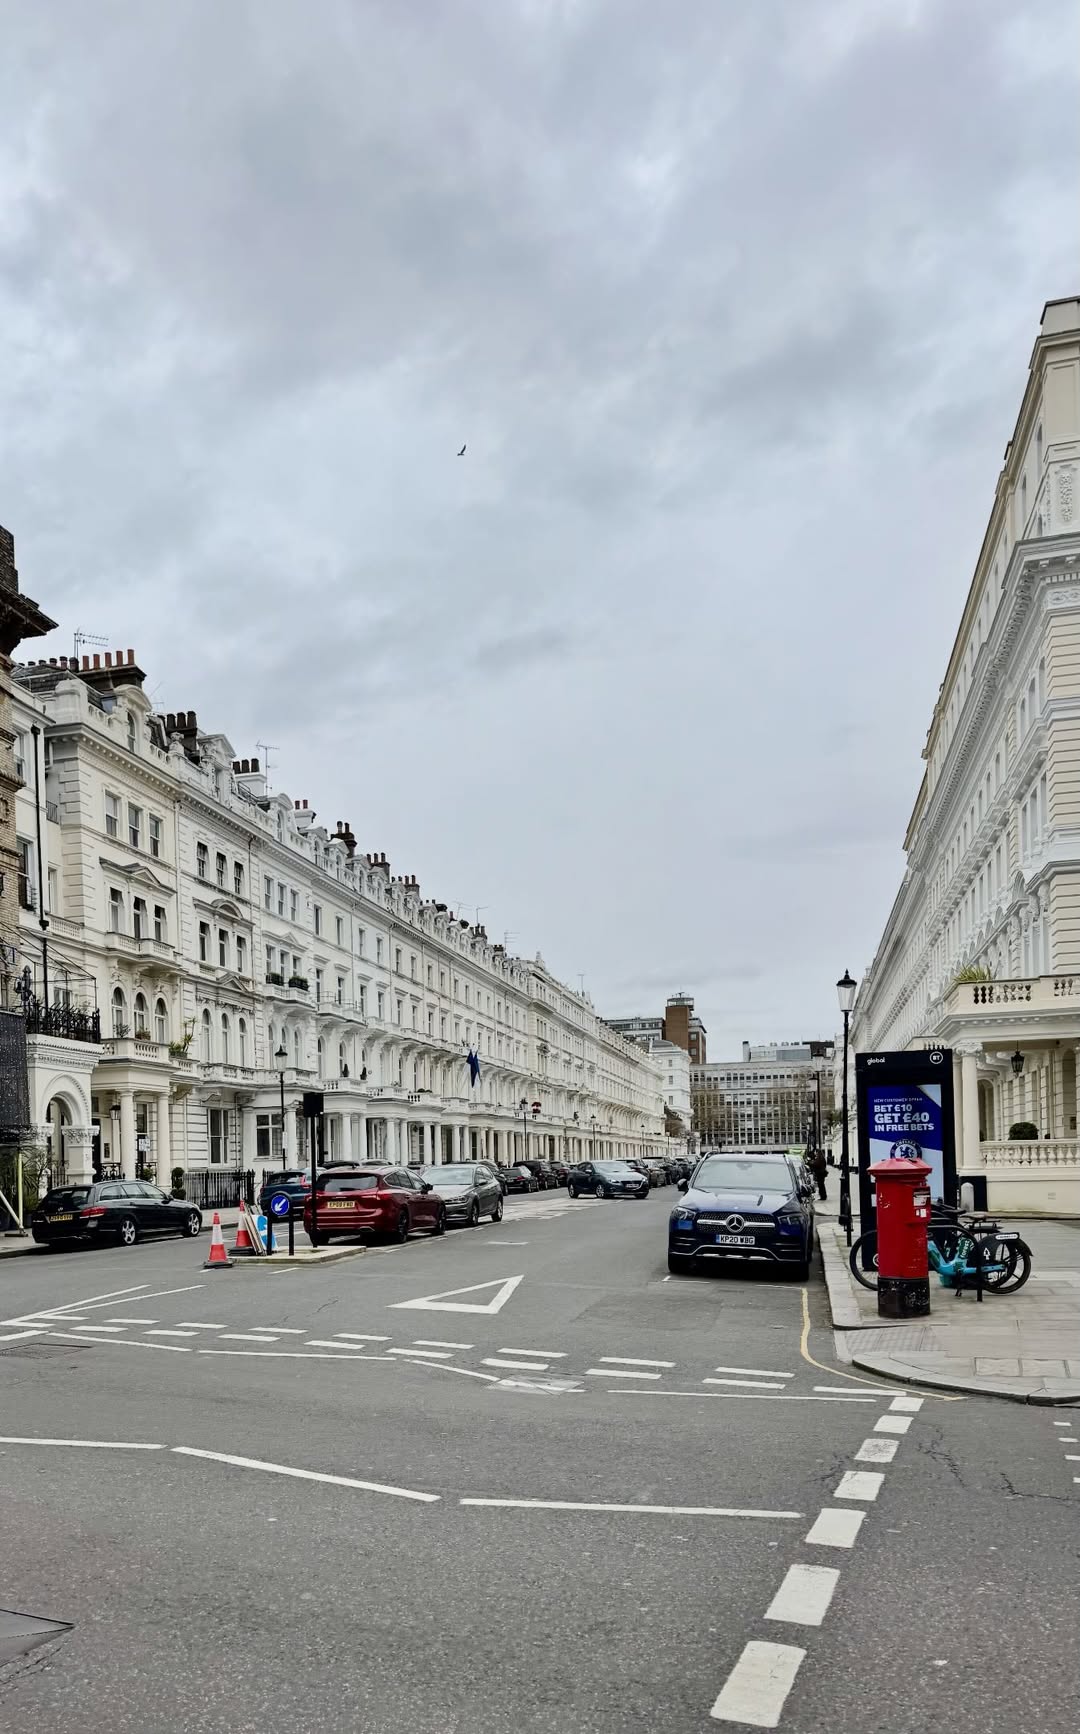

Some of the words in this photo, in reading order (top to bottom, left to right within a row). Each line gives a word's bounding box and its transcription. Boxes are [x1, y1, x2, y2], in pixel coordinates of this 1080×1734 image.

[866, 1056, 886, 1066] global
[873, 1104, 893, 1113] BET
[894, 1103, 913, 1112] £10
[874, 1112, 901, 1124] GET
[902, 1111, 930, 1123] £40
[874, 1124, 885, 1132] IN
[886, 1124, 909, 1132] FREE
[910, 1123, 935, 1131] BETS
[720, 1235, 739, 1243] KP20
